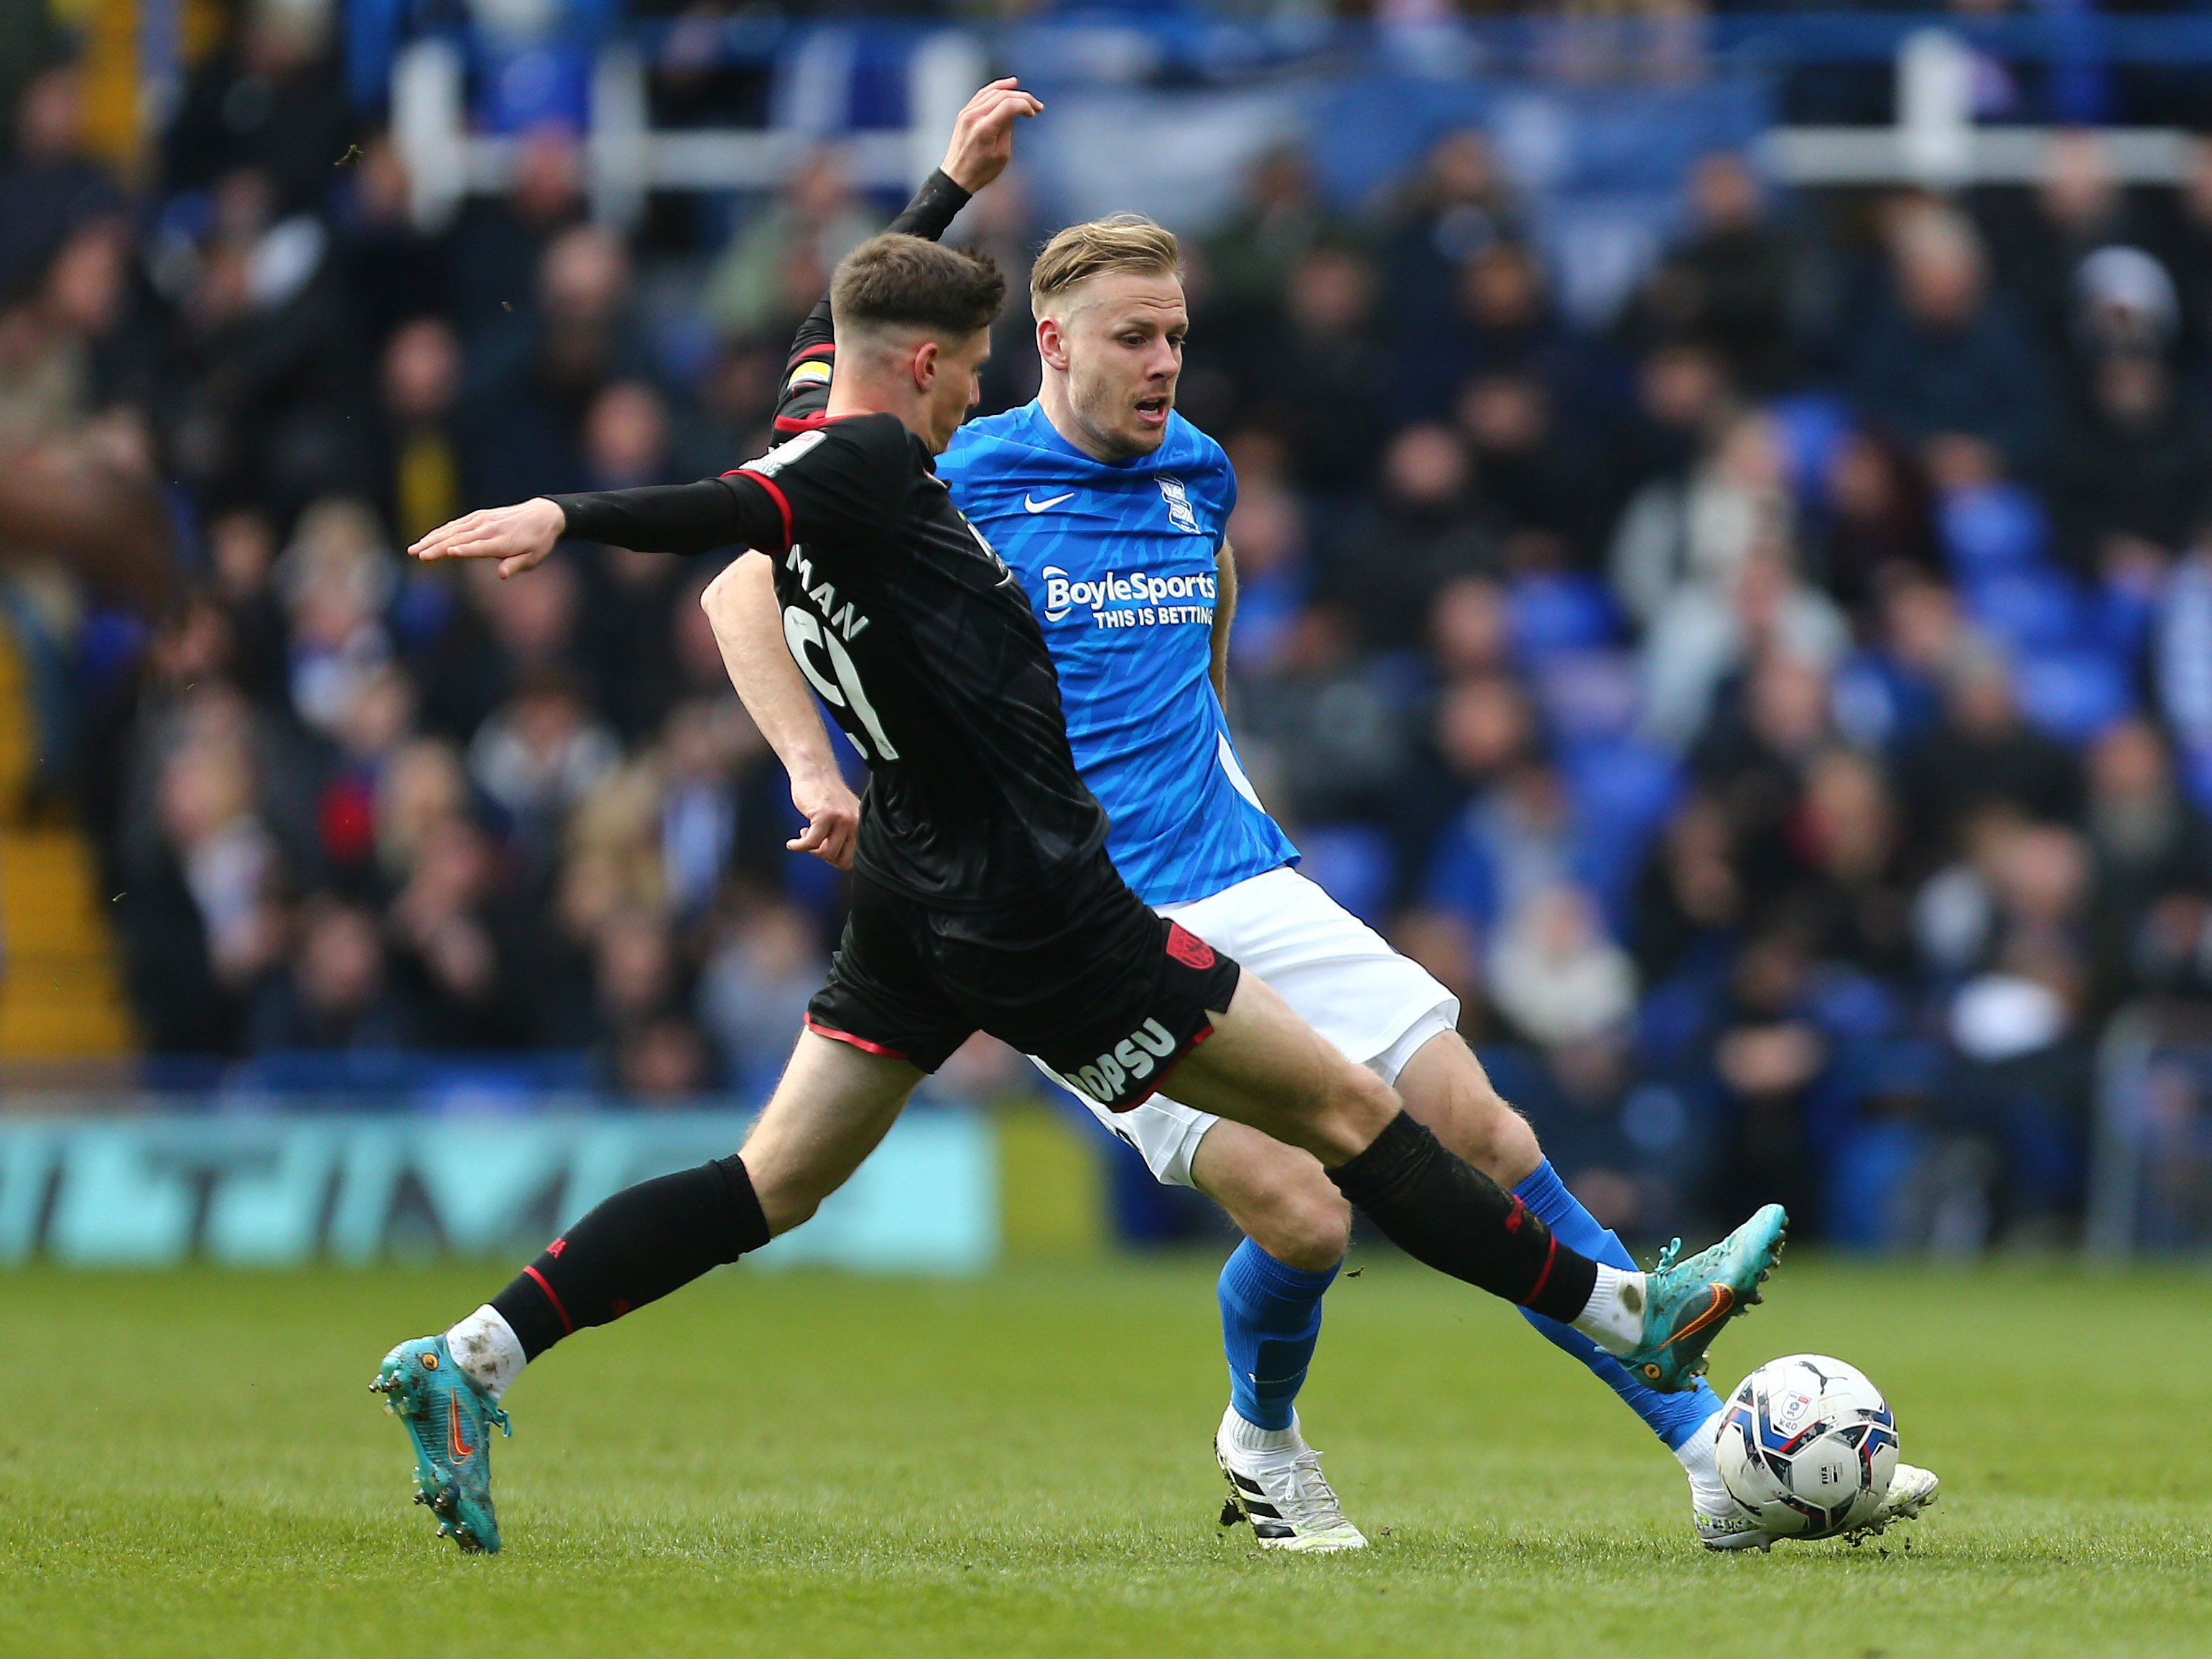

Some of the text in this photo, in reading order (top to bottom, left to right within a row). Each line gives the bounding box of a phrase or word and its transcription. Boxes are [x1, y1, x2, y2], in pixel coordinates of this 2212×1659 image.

[1046, 572, 1217, 610] BoyleSports
[1092, 608, 1135, 629] THIS
[1139, 608, 1156, 626] IS
